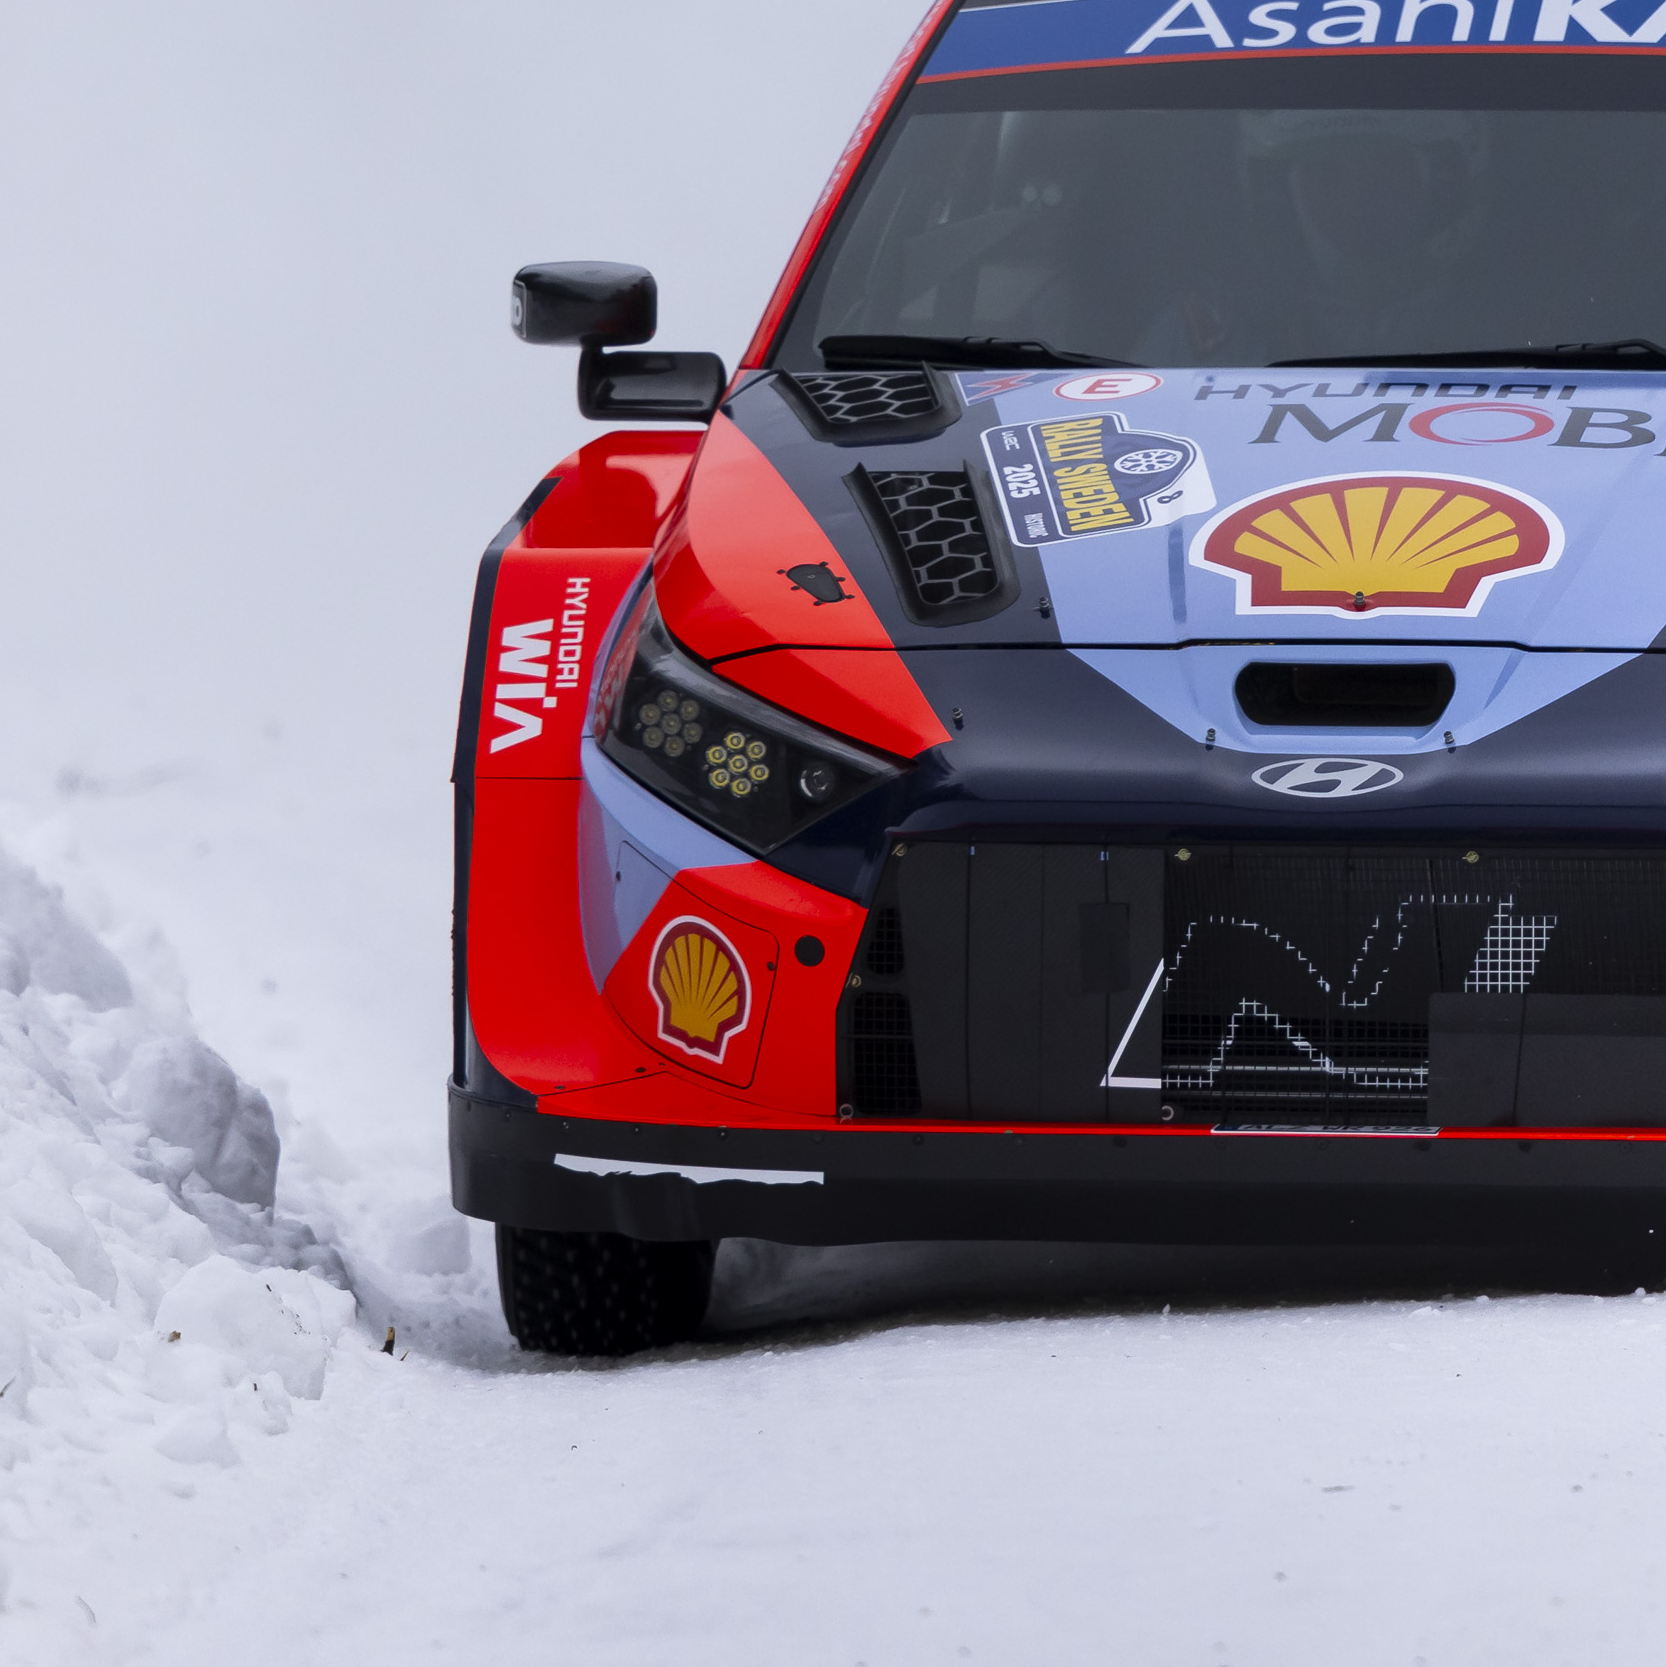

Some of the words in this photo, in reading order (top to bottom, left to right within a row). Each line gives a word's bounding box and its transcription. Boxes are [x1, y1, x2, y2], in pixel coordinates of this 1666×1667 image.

[1082, 373, 1122, 399] E
[1193, 381, 1578, 401] HYUNDAI
[1039, 417, 1104, 463] RALLY
[1002, 463, 1041, 499] 2025
[1052, 462, 1135, 532] SWEDEN
[555, 577, 590, 688] HYUNDAI
